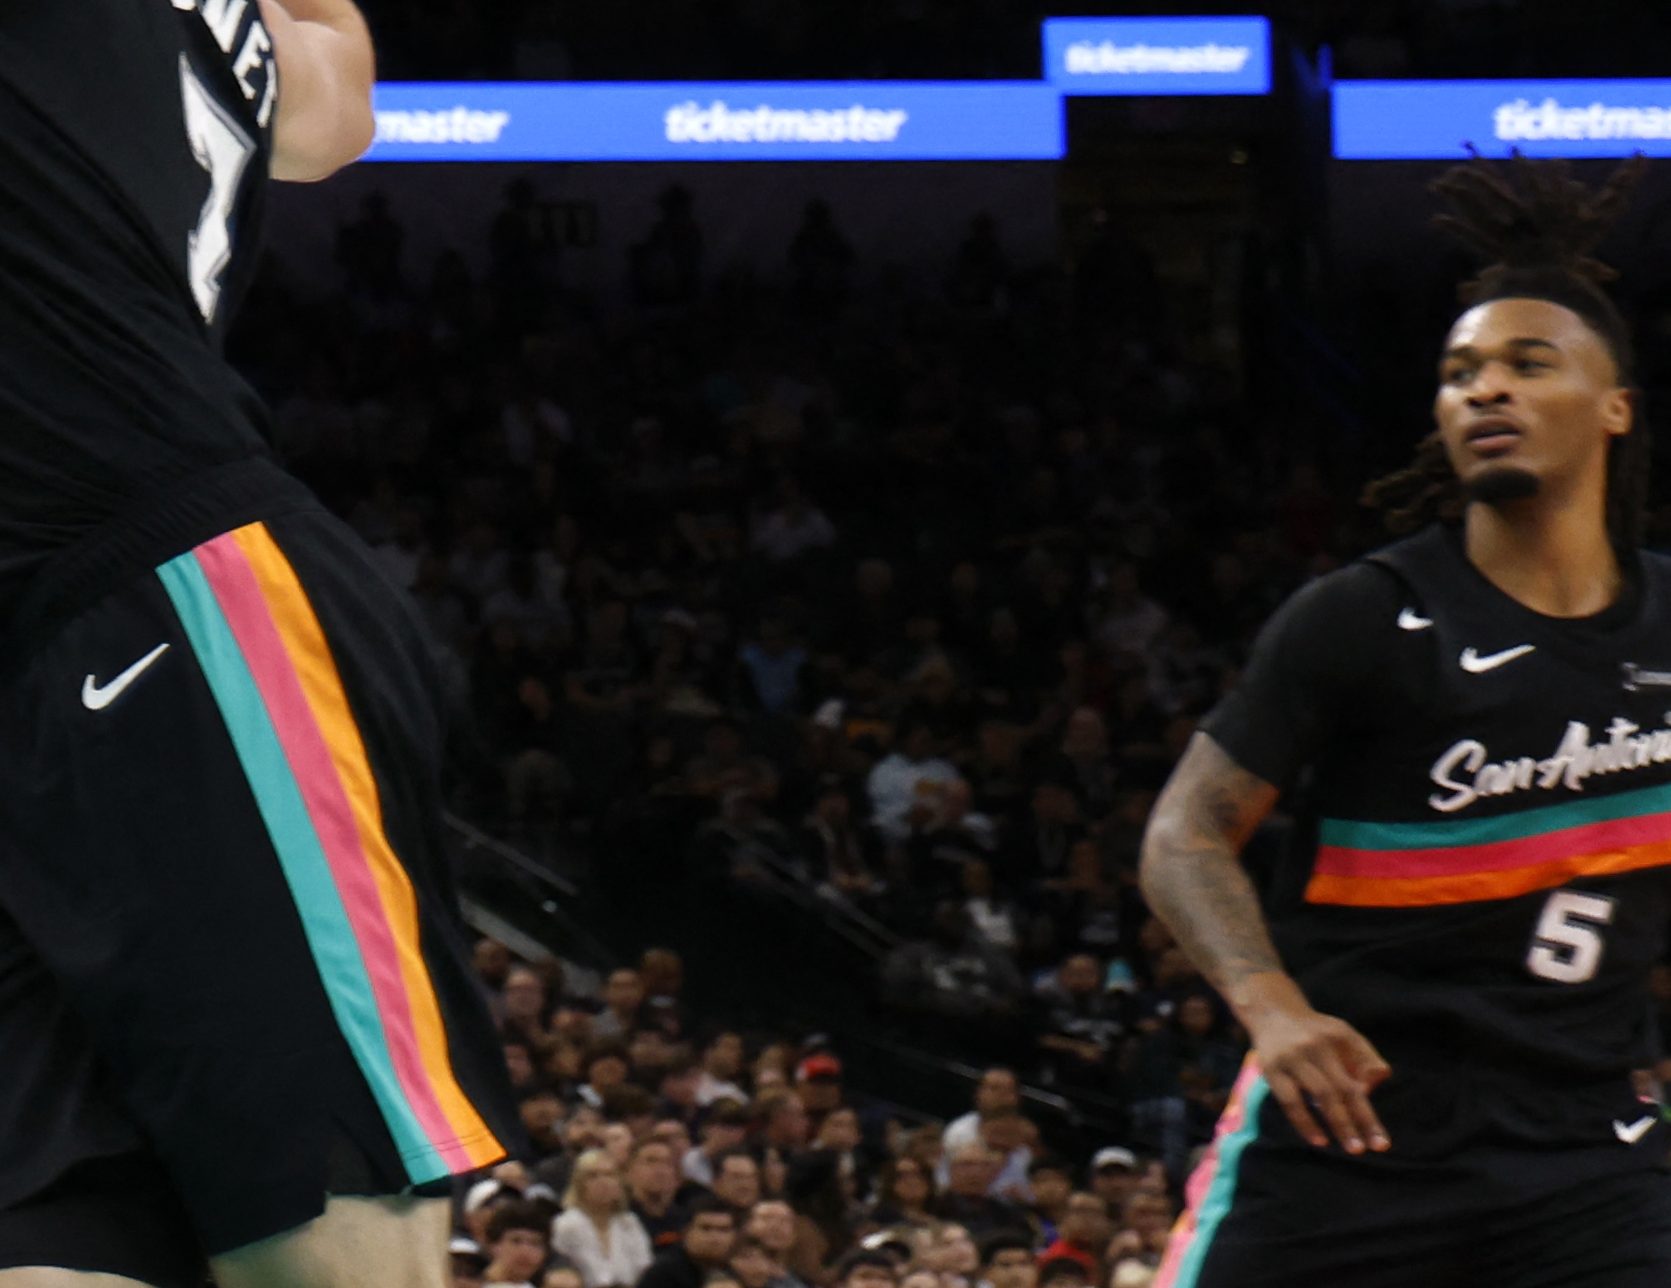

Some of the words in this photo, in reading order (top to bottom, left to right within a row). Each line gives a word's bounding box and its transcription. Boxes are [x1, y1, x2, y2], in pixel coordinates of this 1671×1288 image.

[1064, 40, 1251, 74] ticketmaster
[663, 101, 908, 144] ticketmaster
[179, 50, 258, 326] 7
[1524, 888, 1618, 985] 5
